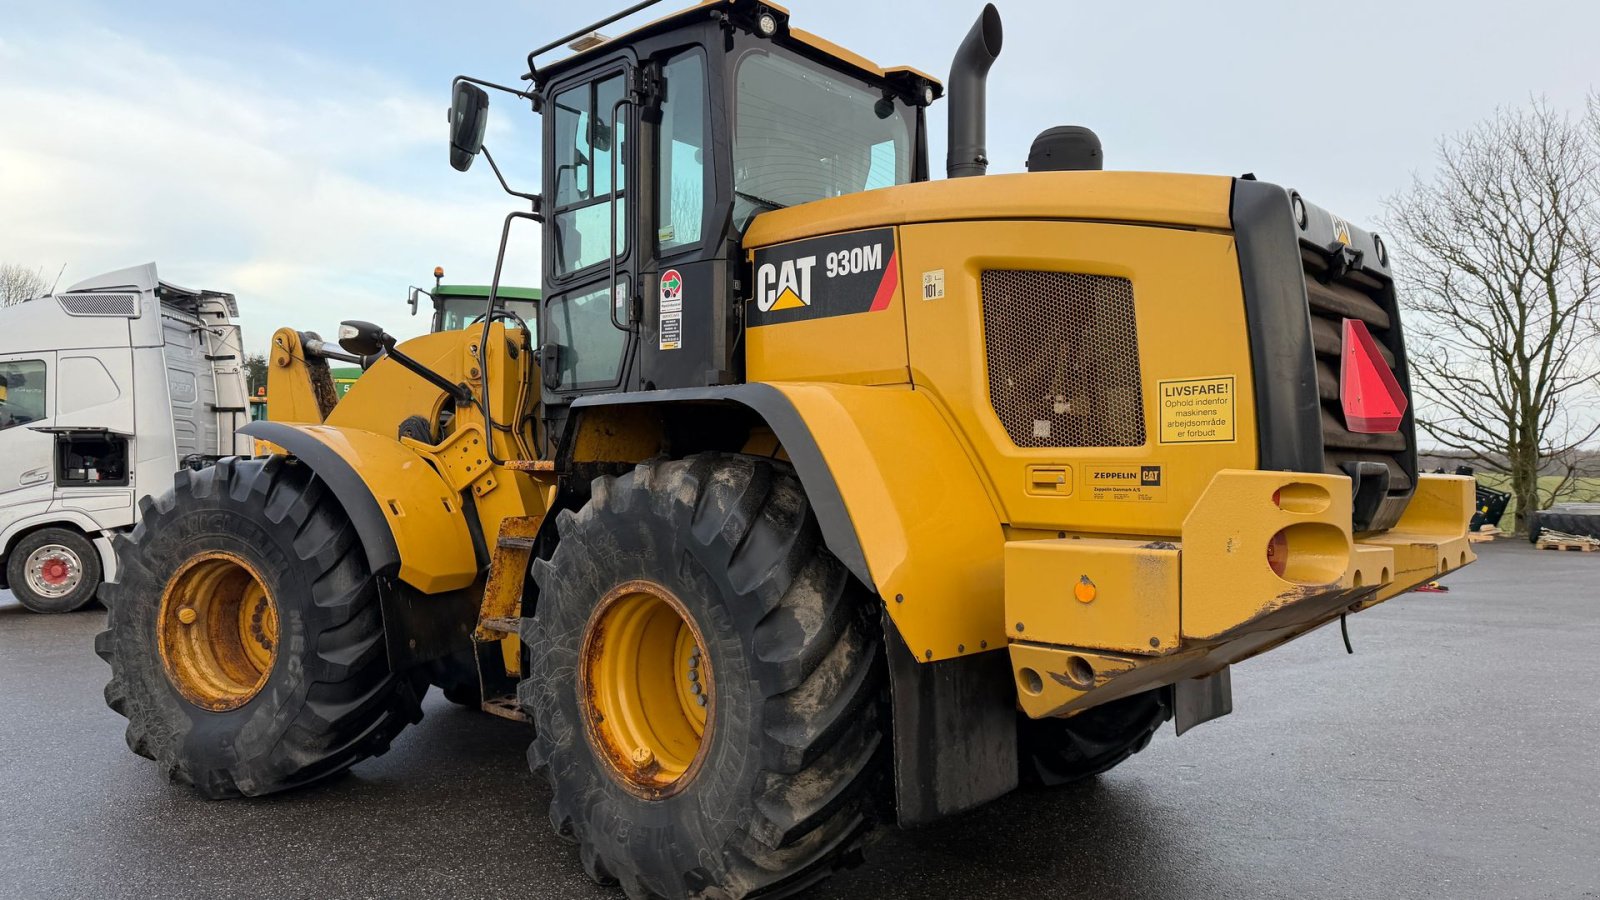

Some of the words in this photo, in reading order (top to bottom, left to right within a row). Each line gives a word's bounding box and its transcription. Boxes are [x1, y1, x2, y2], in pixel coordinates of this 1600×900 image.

[757, 255, 817, 312] CAT
[826, 243, 882, 278] 930M
[924, 283, 936, 298] 101
[1165, 384, 1229, 397] LIVSFARE!
[1165, 399, 1193, 408] Ophold
[1195, 397, 1228, 406] indenfor
[1175, 409, 1218, 417] maskinens
[1167, 418, 1226, 429] arbejdsområde
[1187, 429, 1216, 437] forbudt
[1142, 470, 1159, 481] CAT
